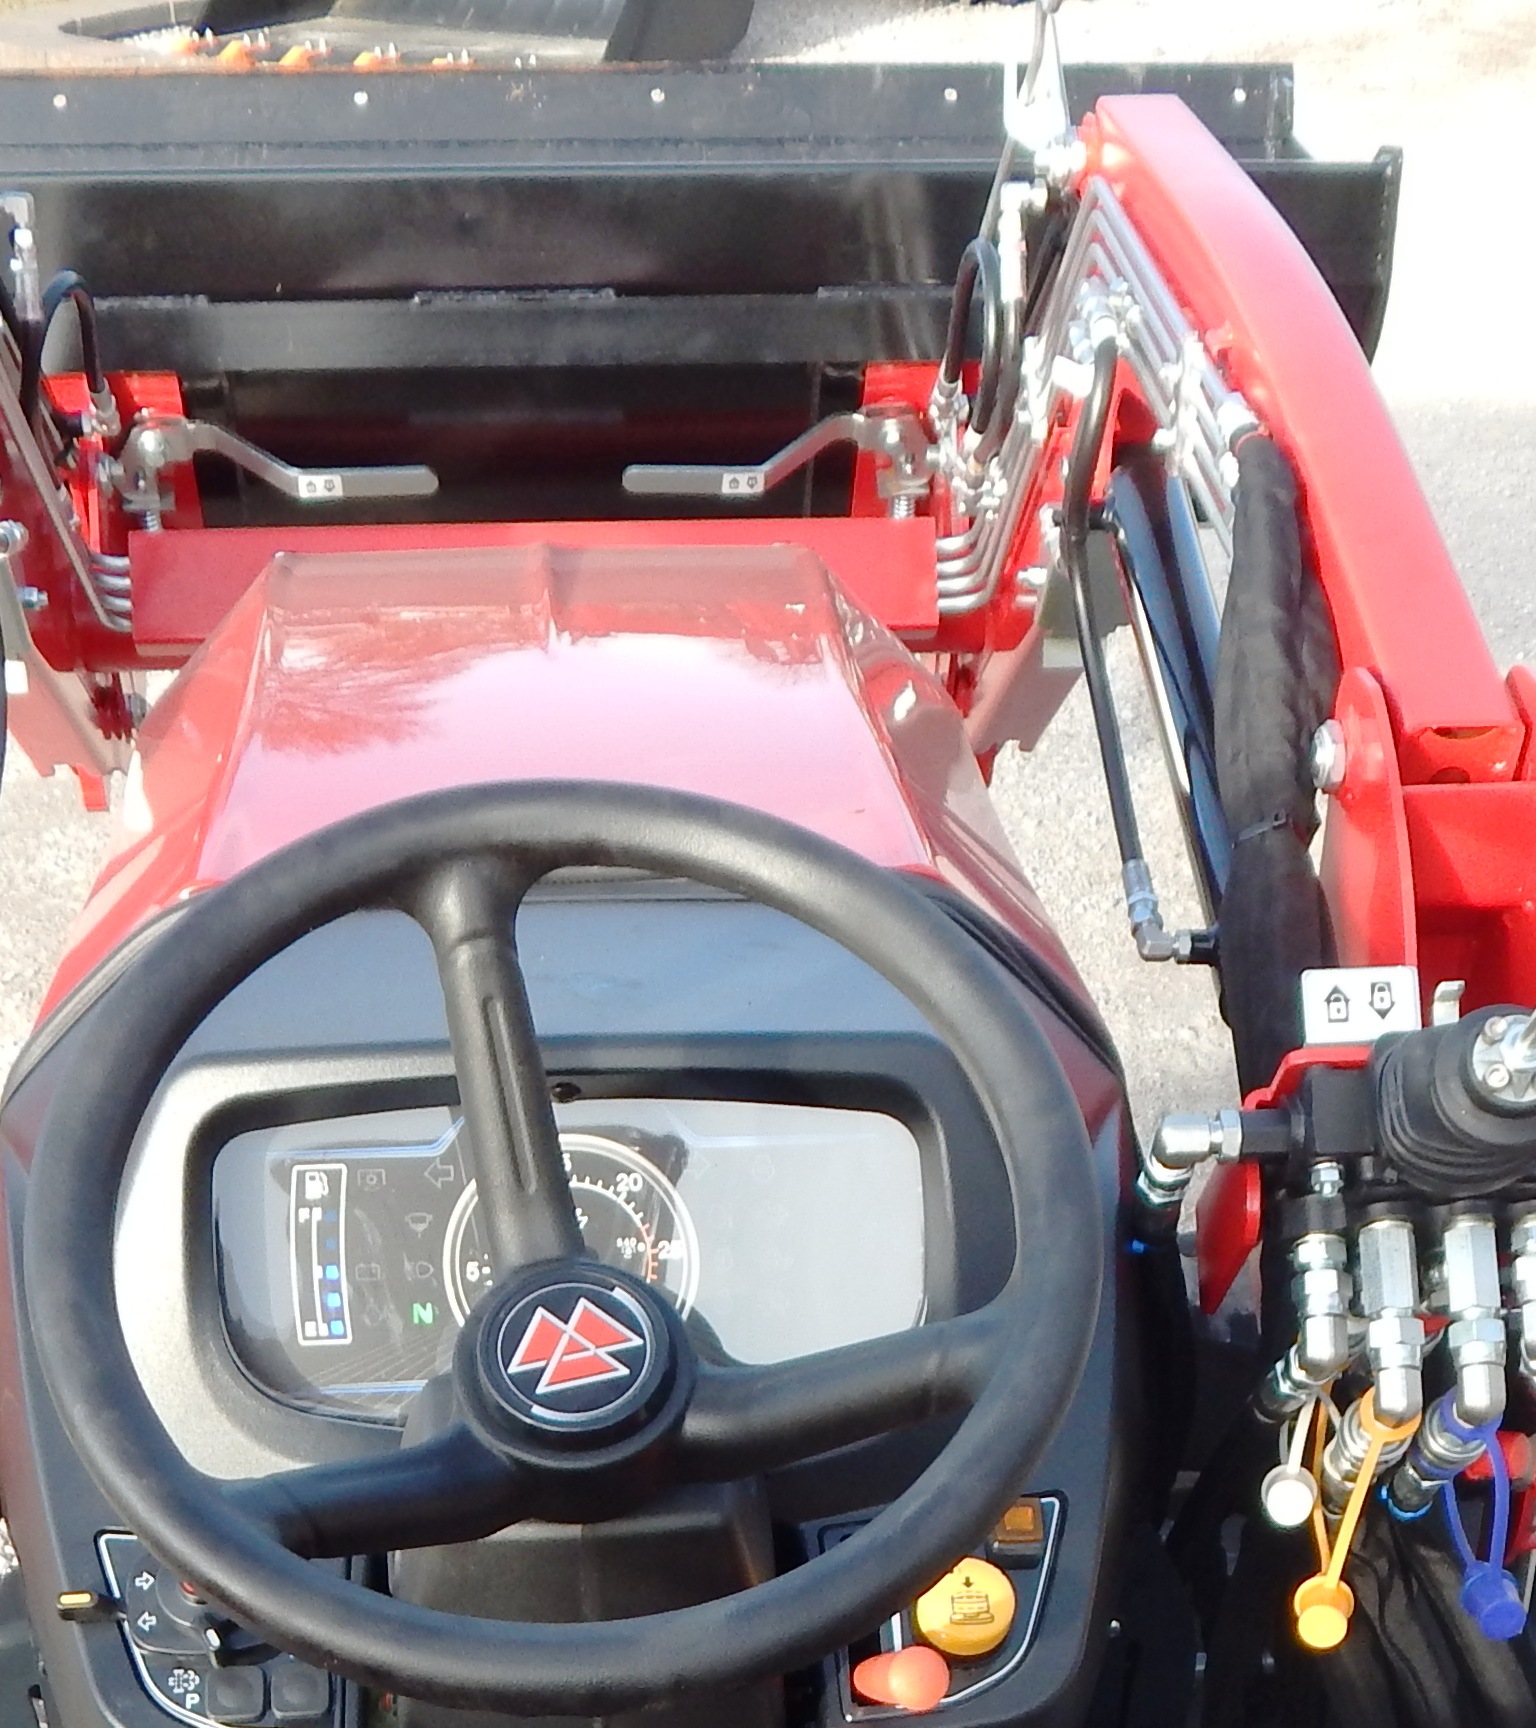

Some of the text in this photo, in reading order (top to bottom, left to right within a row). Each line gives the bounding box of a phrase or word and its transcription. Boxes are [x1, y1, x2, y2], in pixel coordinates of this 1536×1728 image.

[616, 1173, 643, 1192] 20
[465, 1261, 480, 1282] 5
[412, 1302, 434, 1325] N
[185, 1693, 200, 1709] P
